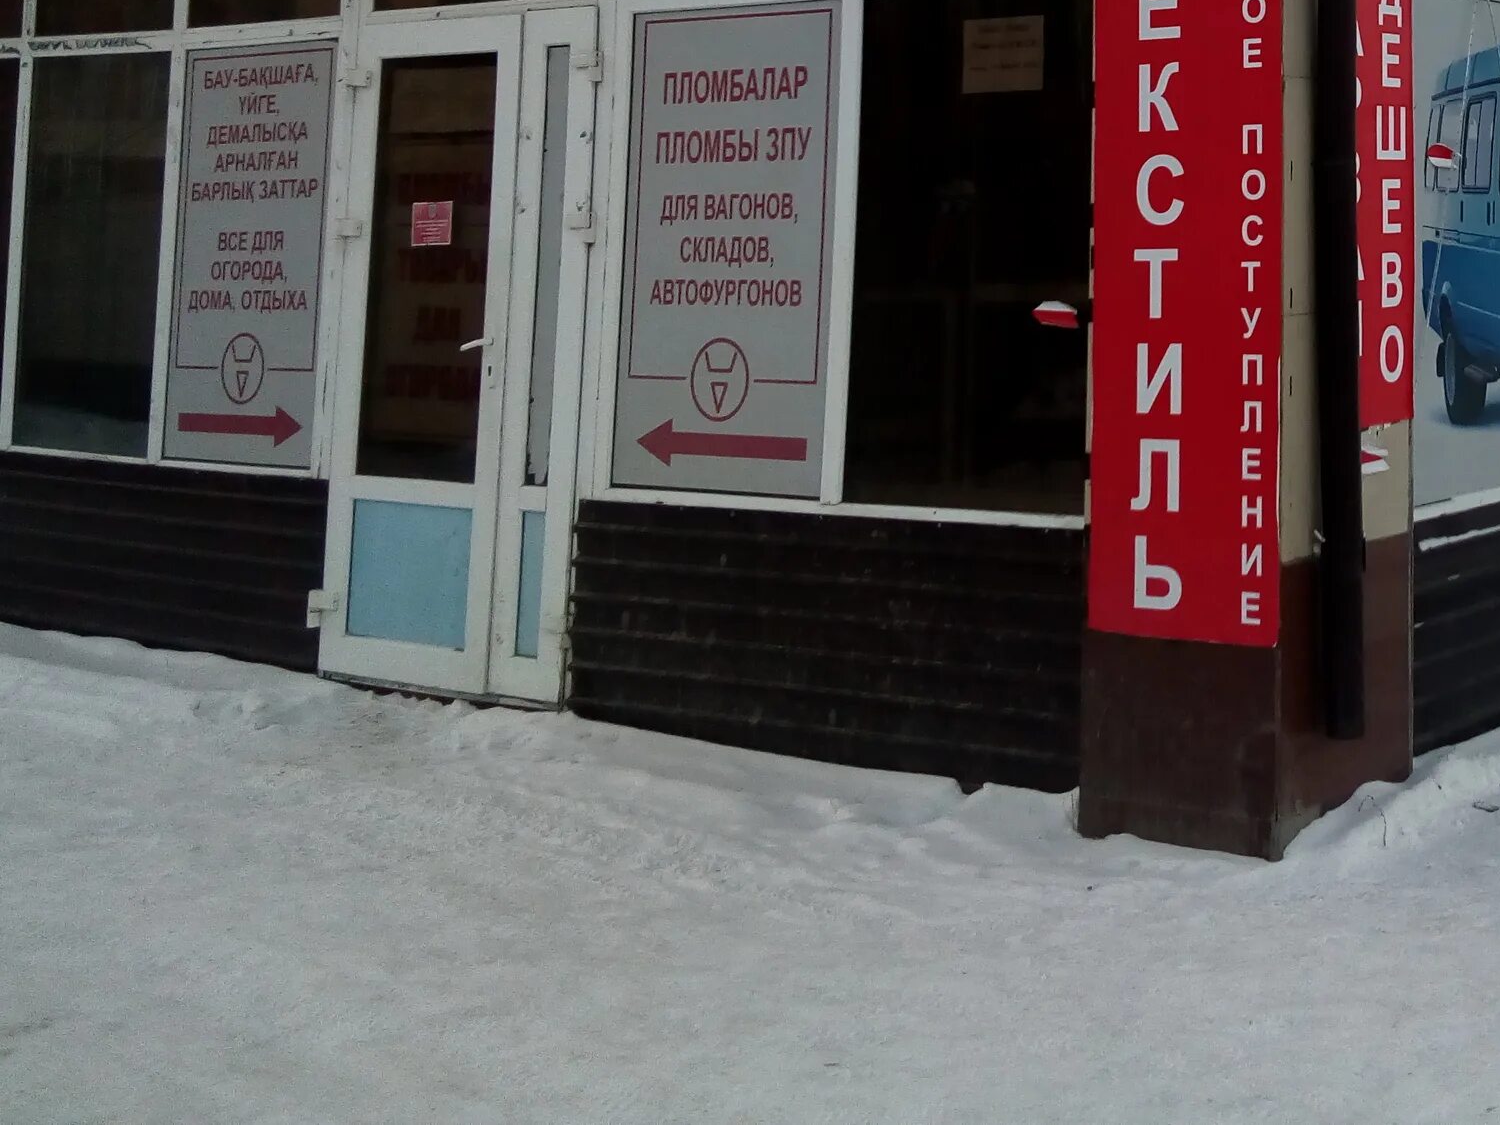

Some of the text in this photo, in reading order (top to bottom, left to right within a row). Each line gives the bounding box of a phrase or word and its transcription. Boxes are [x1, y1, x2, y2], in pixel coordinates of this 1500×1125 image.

[204, 63, 319, 91] БАУ-БАҚШАҒА,
[663, 65, 809, 105] ПЛОМБАЛАР
[238, 92, 280, 116] ҮЙГЕ,
[206, 121, 309, 148] ДЕМАЛЫСҚА
[655, 126, 813, 165] ПЛОМБЫ ЗПУ
[214, 150, 299, 173] АРНАЛҒАН
[191, 178, 319, 204] БАРЛЫҚ ЗАТТАР
[660, 192, 798, 226] ДЛЯ ВАГОНОВ,
[218, 230, 285, 255] ВСЕ ДЛЯ
[680, 236, 775, 268] СКЛАДОВ,
[210, 260, 288, 285] ОГОРОДА,
[188, 289, 308, 315] ДОМА, ОТДЫХА
[650, 279, 802, 307] АВТОФУРГОНОВ
[1239, 123, 1267, 627] ПОСТУПЛЕНИЕ
